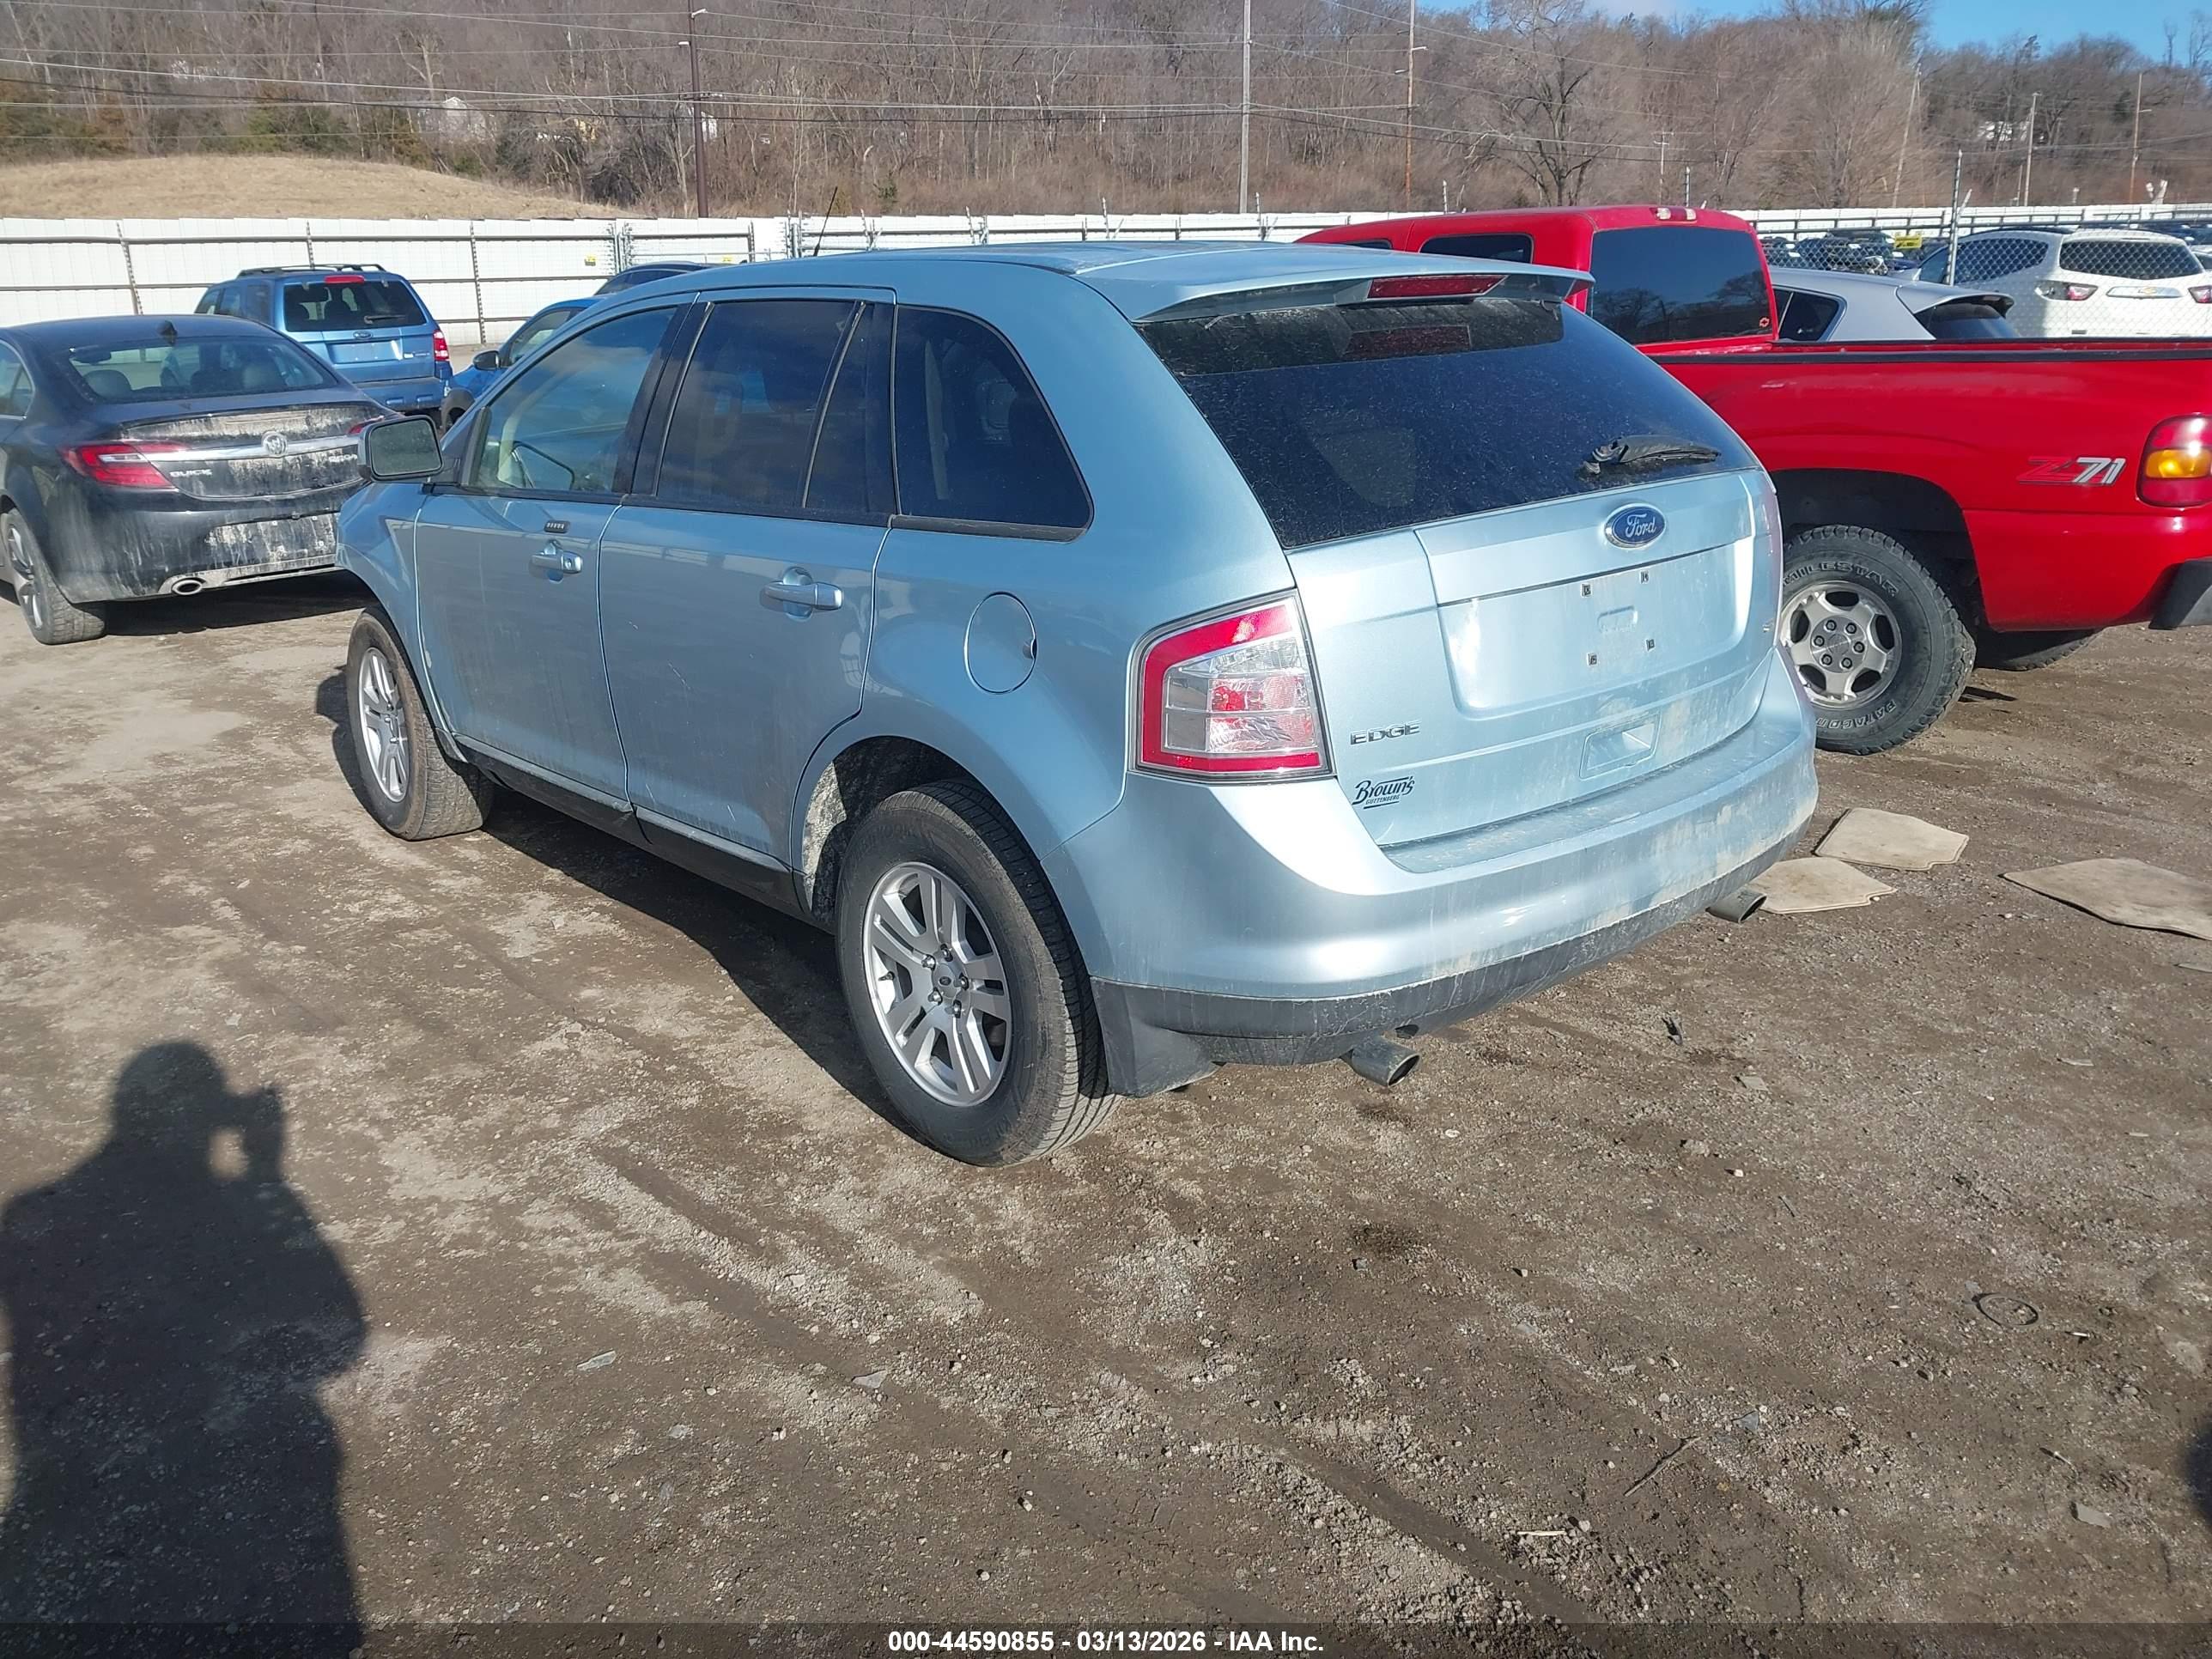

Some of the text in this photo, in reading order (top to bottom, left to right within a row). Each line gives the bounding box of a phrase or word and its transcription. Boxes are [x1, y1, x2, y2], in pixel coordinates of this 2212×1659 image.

[169, 469, 213, 478] BUICK
[2015, 456, 2126, 485] Z71
[1625, 513, 1657, 538] Ford
[1350, 721, 1421, 745] EDGE
[1352, 775, 1415, 805] Brown's
